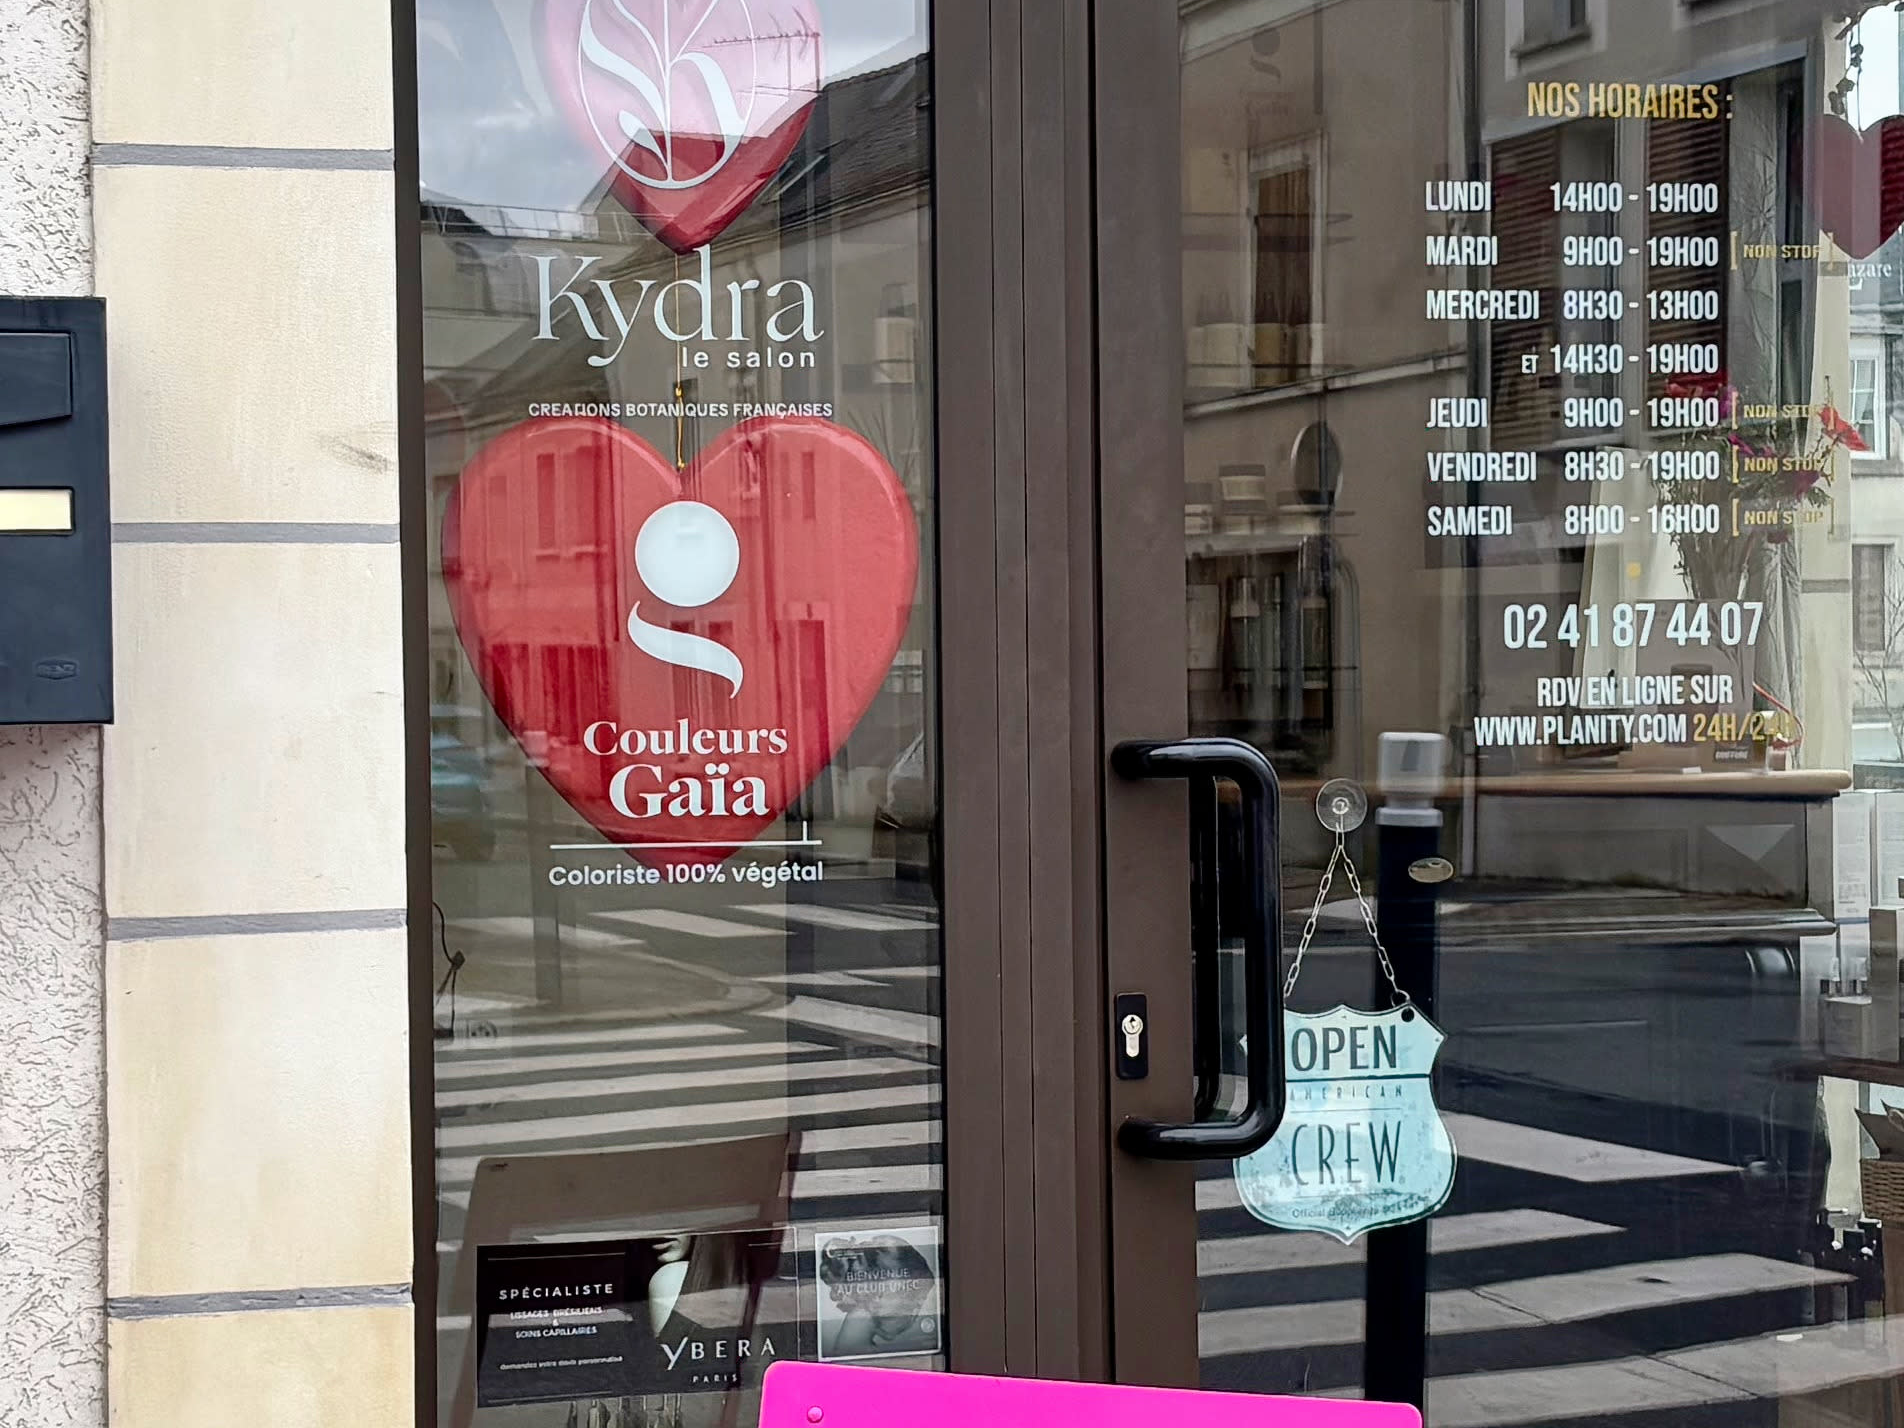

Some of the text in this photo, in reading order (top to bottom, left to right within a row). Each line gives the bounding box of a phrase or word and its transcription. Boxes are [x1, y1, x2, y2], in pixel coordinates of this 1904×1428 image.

[1527, 82, 1580, 117] NOS
[1589, 83, 1718, 119] HORAIRES
[1425, 181, 1491, 212] LUNDI
[1550, 182, 1623, 213] 14H00
[1646, 183, 1718, 213] 19H00
[1425, 235, 1498, 266] MARDI
[1563, 236, 1623, 266] 9H00
[1646, 237, 1719, 267] 19H00
[1744, 245, 1776, 258] NON
[528, 244, 824, 368] Kydra
[1426, 290, 1540, 320] MERCREDI
[1563, 291, 1623, 320] 8H30
[1646, 291, 1719, 320] 13H00
[682, 347, 815, 368] le salon
[1521, 354, 1539, 374] ET
[1550, 344, 1623, 375] 14H30
[1646, 345, 1719, 374] 19H00
[626, 403, 728, 417] BOTANIQUES
[733, 403, 833, 420] FRANÇAISES
[1426, 397, 1488, 428] JEUDI
[1564, 398, 1624, 428] 9H00
[1647, 397, 1719, 427] 19H00
[1744, 404, 1777, 418] NON
[1427, 452, 1537, 482] VENDREDI
[1564, 452, 1624, 481] 8H30
[1647, 451, 1720, 481] 19H00
[1744, 457, 1778, 472] NON
[1427, 506, 1513, 536] SAMEDI
[1564, 505, 1625, 535] 8H00
[1648, 504, 1720, 535] 16H00
[1744, 511, 1824, 524] NON SOP
[1503, 602, 1764, 650] 02 41 87 44 07
[1537, 674, 1733, 708] RDV EN LIGNE SUR
[583, 718, 788, 757] Couleurs
[1474, 713, 1687, 746] WWW.PLANITY.COM
[609, 762, 770, 818] Gaïa
[549, 861, 823, 889] Coloriste 100% végétal
[1291, 1024, 1397, 1071] OPEN
[1290, 1085, 1402, 1100] AMERICAN
[1292, 1121, 1401, 1185] CREW
[499, 1284, 613, 1300] SPÉCIALISTE
[692, 1374, 737, 1383] PARIS
